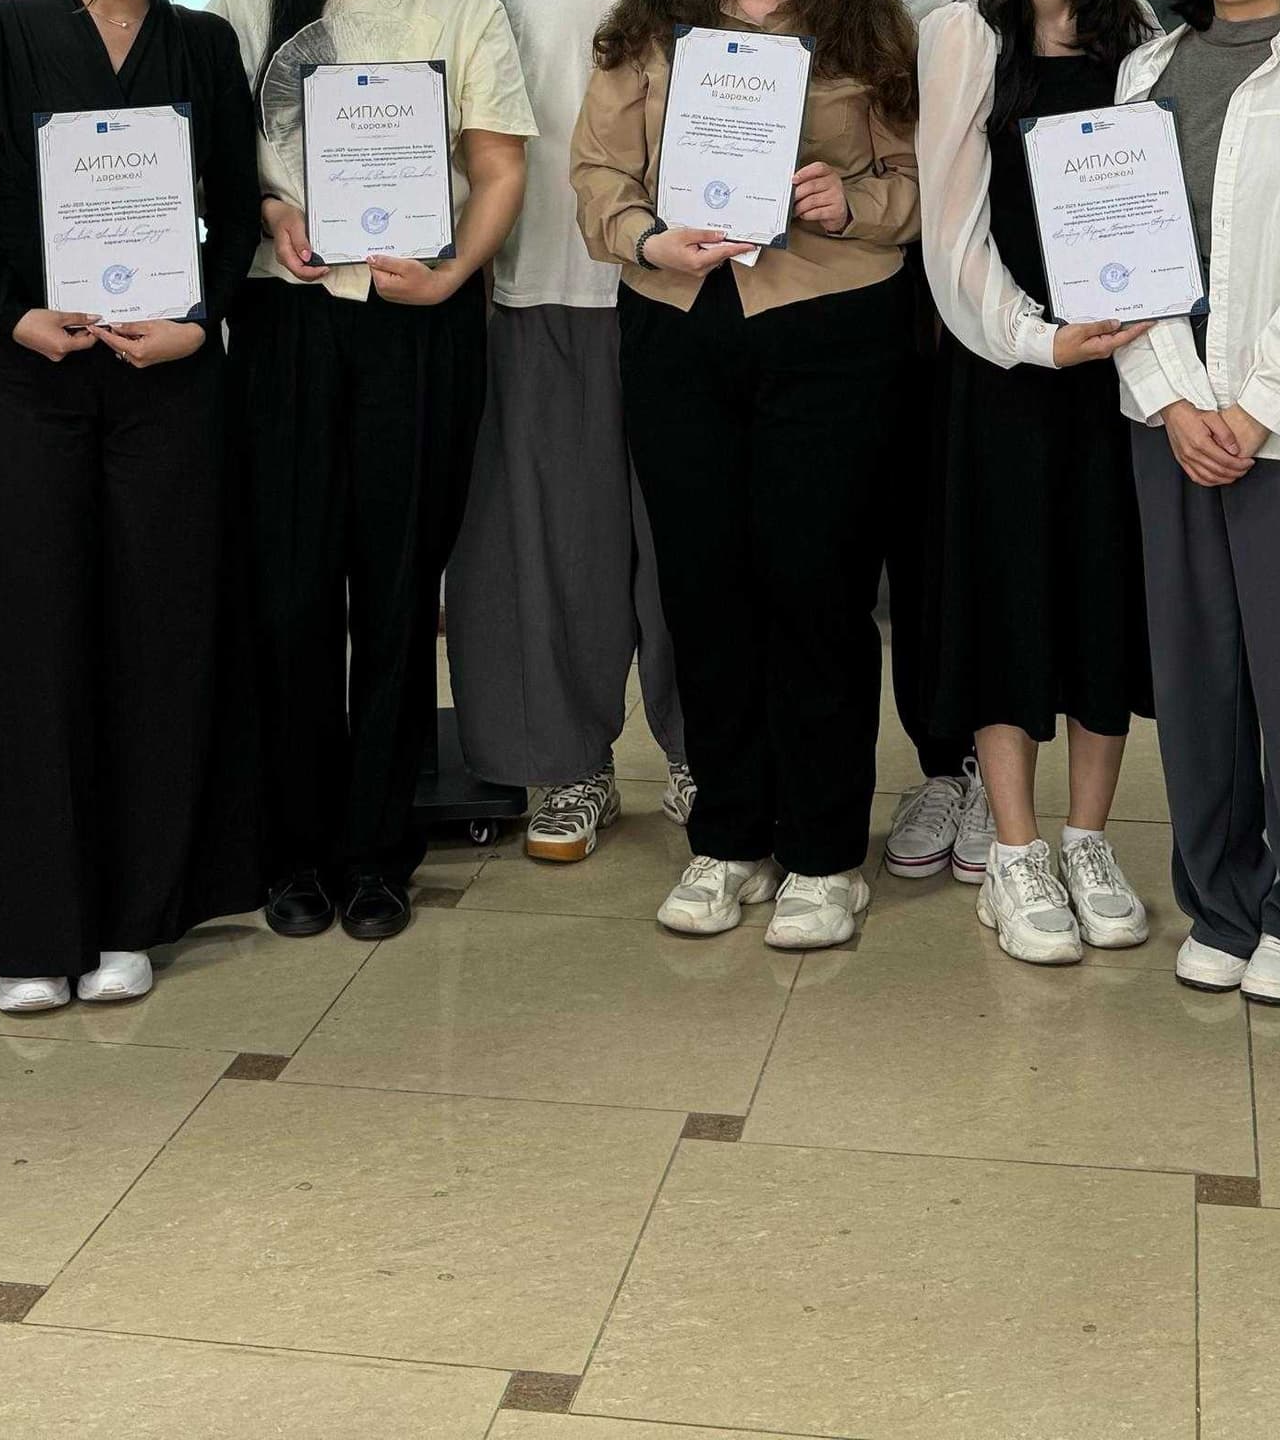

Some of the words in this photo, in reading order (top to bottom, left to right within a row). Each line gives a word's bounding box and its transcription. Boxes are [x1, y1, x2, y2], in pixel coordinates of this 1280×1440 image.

[701, 73, 777, 93] ДИПЛОМ
[336, 104, 414, 120] ДИПЛОМ
[75, 152, 158, 173] ДИПЛОМ
[1064, 148, 1147, 175] ДИПЛОМ
